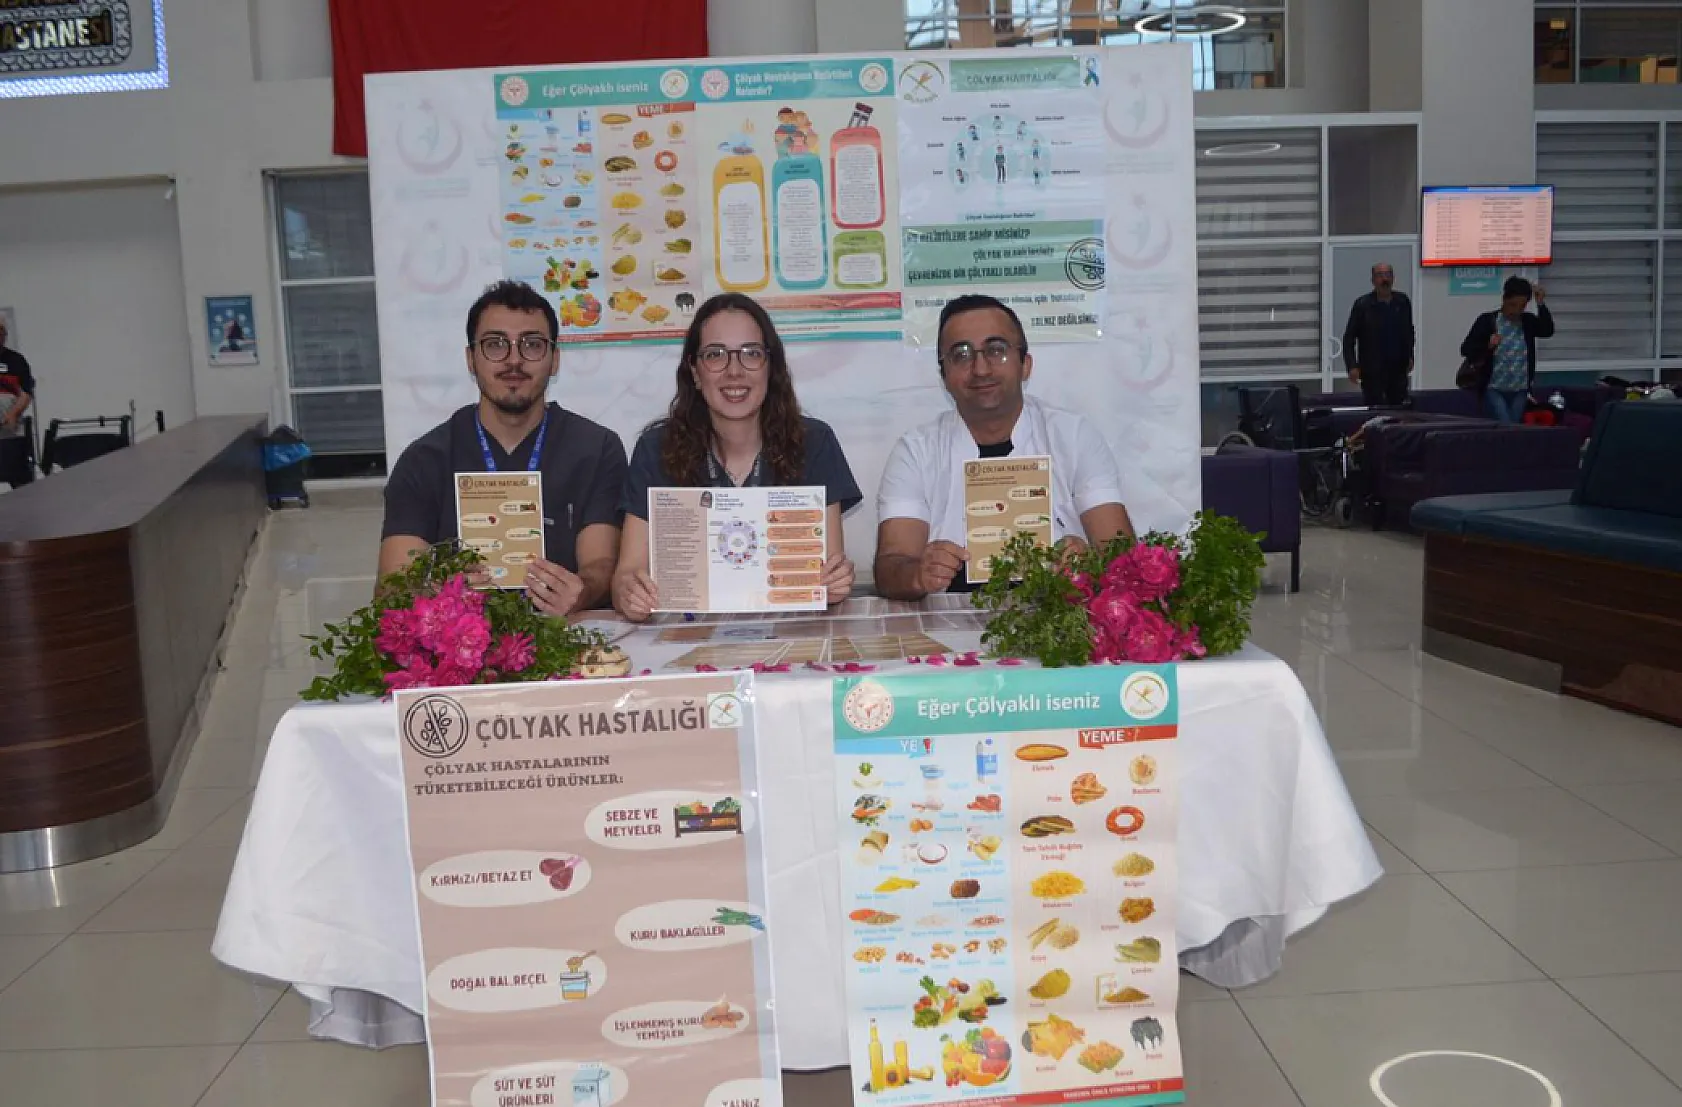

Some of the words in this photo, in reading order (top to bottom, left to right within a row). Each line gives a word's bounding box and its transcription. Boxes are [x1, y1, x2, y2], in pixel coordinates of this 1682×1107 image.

[917, 698, 960, 720] Eğer
[966, 693, 1041, 718] Çölyaklı
[1046, 691, 1100, 711] iseniz
[475, 713, 572, 749] ÇÖLYAK
[579, 700, 705, 737] HASTALIĞI
[1082, 729, 1126, 743] YEME
[424, 762, 488, 778] ÇÖLYAK
[490, 755, 610, 772] HASTALARININ
[414, 774, 542, 796] TÜKETEBİLECEĞİ
[546, 773, 624, 788] ÜRÜNLER:
[605, 809, 641, 823] SEBZE
[643, 808, 659, 820] VE
[520, 869, 532, 882] ET
[630, 930, 657, 941] KURU
[494, 1077, 515, 1092] SÜT
[517, 1078, 532, 1090] VE
[535, 1075, 556, 1089] SÜT
